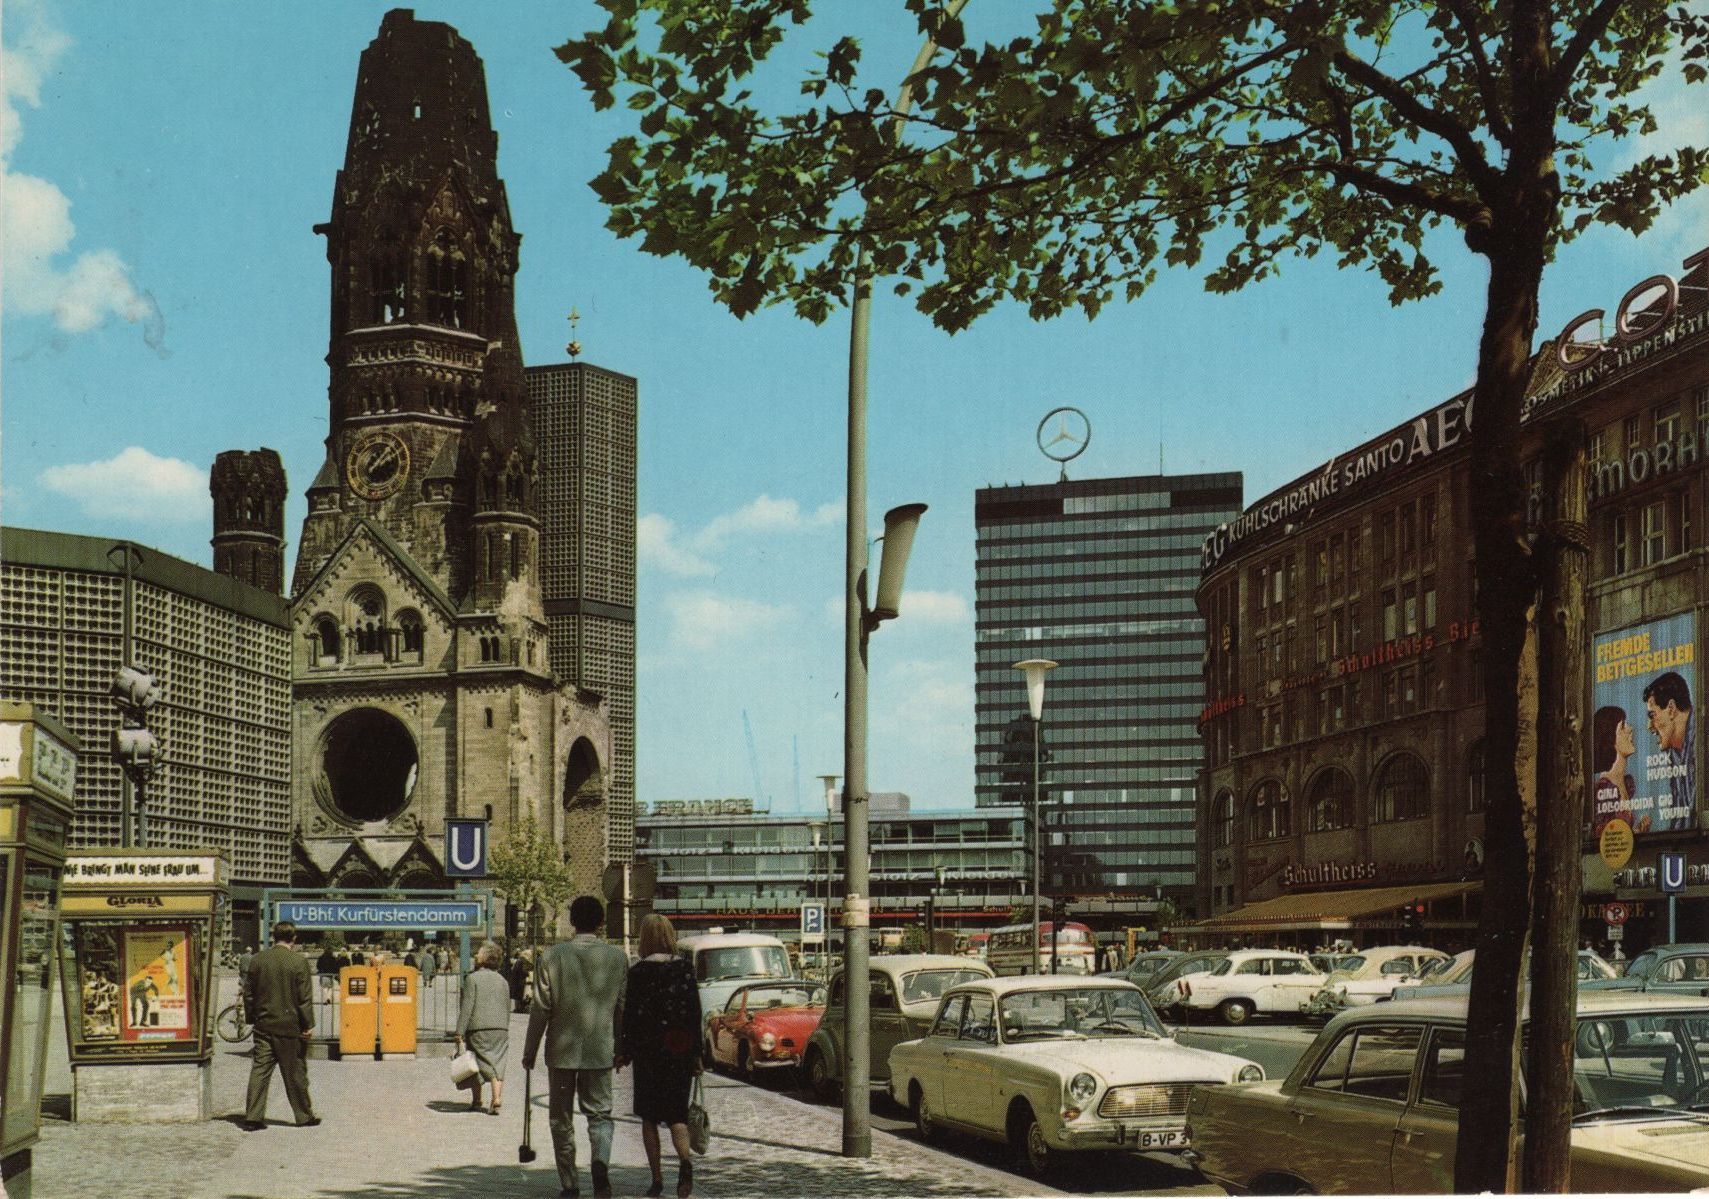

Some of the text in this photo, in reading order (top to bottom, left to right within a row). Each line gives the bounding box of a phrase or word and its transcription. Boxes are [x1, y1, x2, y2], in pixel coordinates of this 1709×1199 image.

[1344, 437, 1404, 488] SANTO
[1597, 632, 1650, 663] FREMDE
[1597, 641, 1694, 683] BETTGESELLEN
[1646, 751, 1672, 767] ROCK
[1646, 764, 1688, 781] HUDSON
[1597, 787, 1619, 801] GINA
[1658, 794, 1674, 808] GIG
[1659, 806, 1690, 821] YOUNG
[451, 826, 482, 871] U
[1283, 860, 1377, 887] Schultheiss
[1665, 857, 1684, 887] U
[106, 895, 164, 908] GLORIA
[291, 907, 467, 922] U-Bhf. Kurfürstendamm
[1142, 1132, 1176, 1147] B-VP
